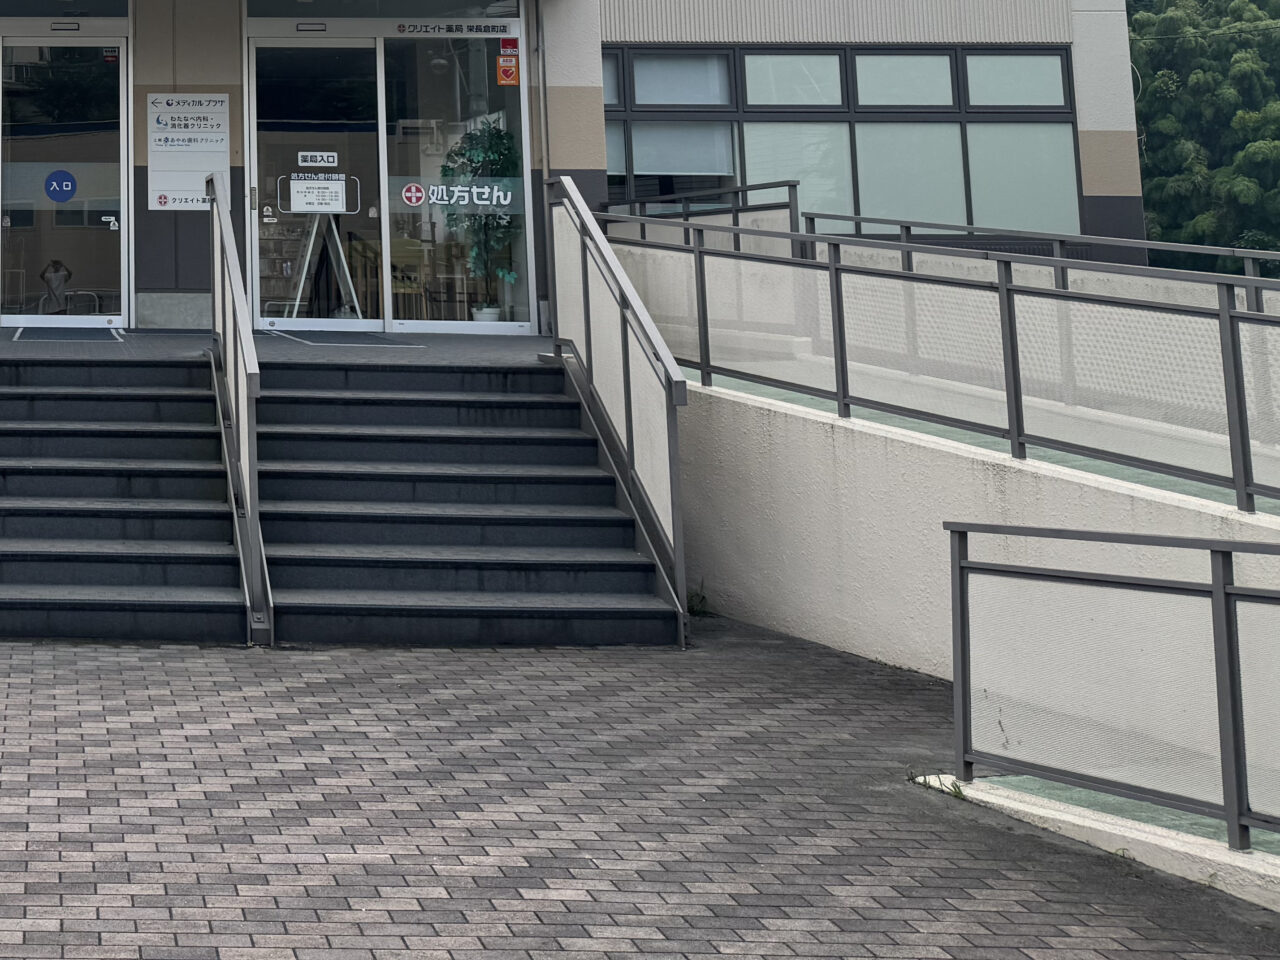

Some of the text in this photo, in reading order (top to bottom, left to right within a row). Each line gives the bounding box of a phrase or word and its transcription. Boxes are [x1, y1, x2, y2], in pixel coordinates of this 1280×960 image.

[407, 24, 464, 34] クリエイト薬局
[300, 154, 335, 164] 薬局入口
[50, 181, 72, 191] 入口
[428, 185, 512, 205] 処方せん
